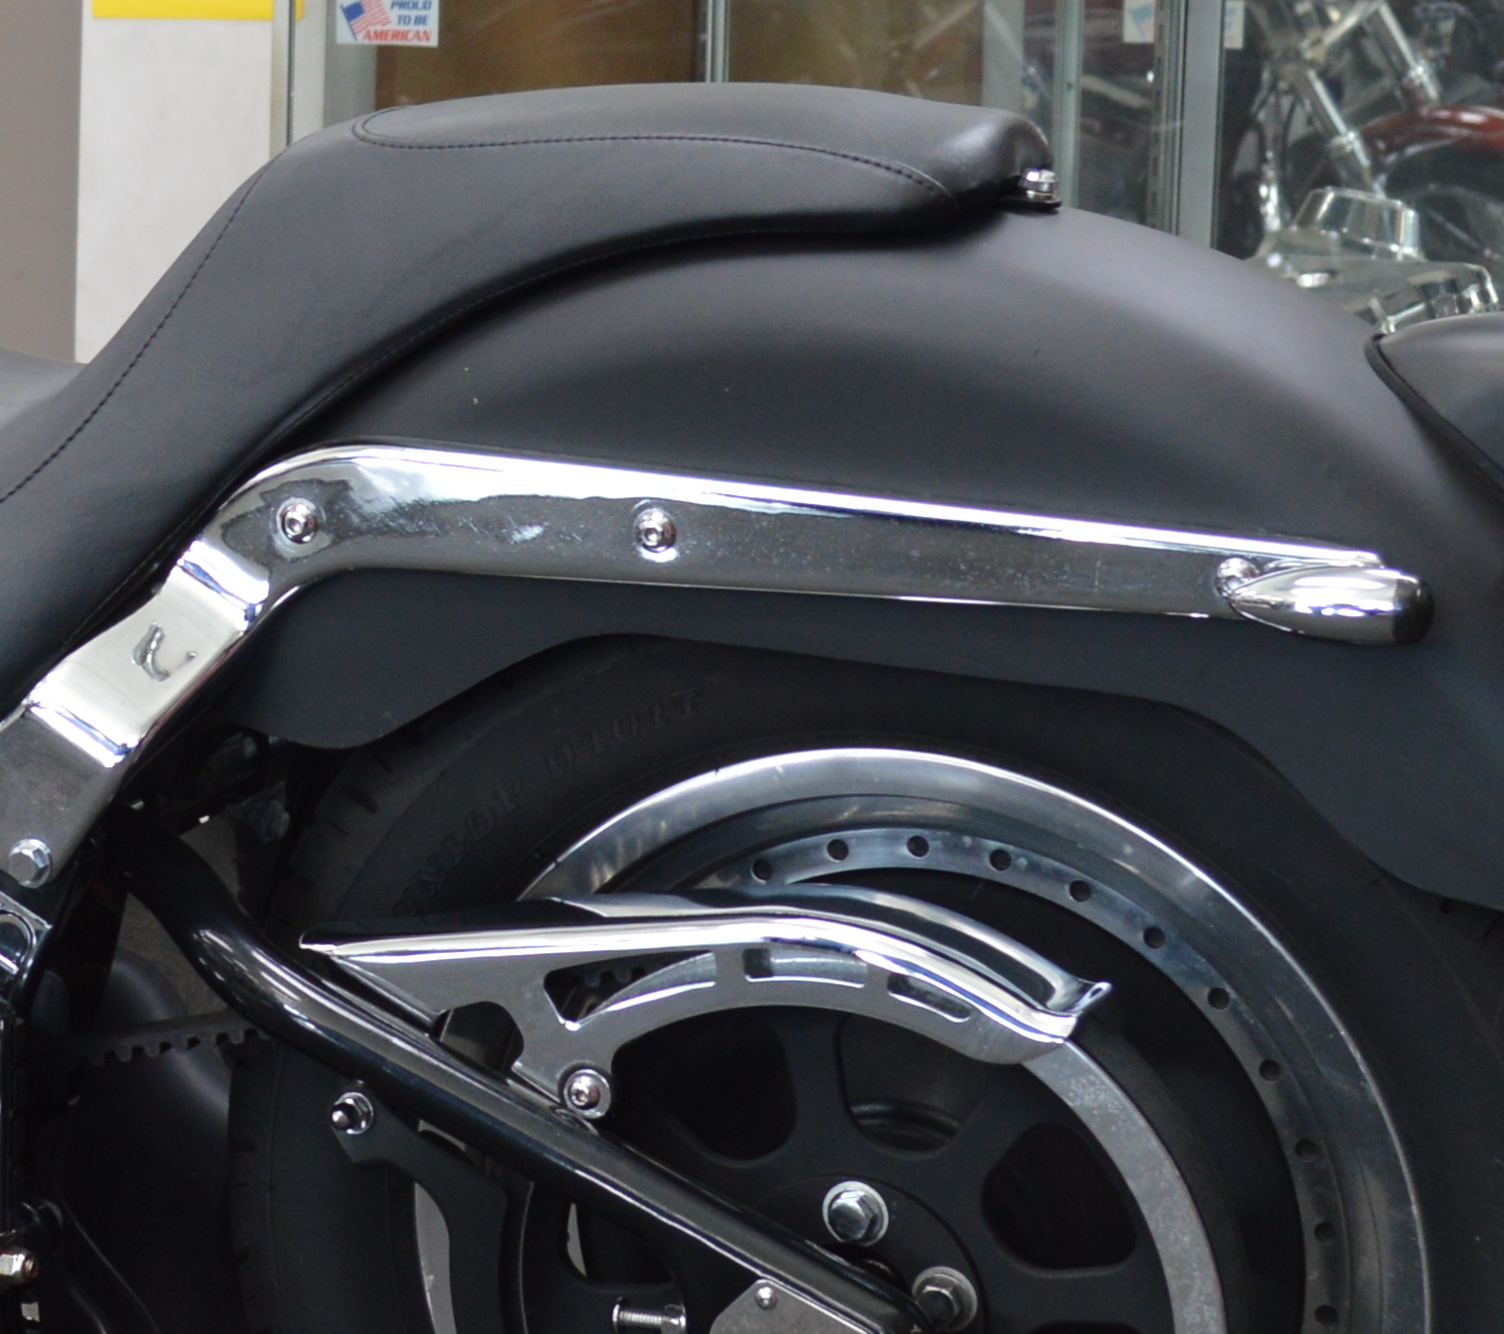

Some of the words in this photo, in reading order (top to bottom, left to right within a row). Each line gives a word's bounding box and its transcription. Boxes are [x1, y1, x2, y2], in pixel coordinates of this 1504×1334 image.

[390, 0, 432, 11] PROUD
[397, 15, 411, 26] TO
[414, 15, 429, 26] BE
[362, 29, 432, 43] AMERICAN
